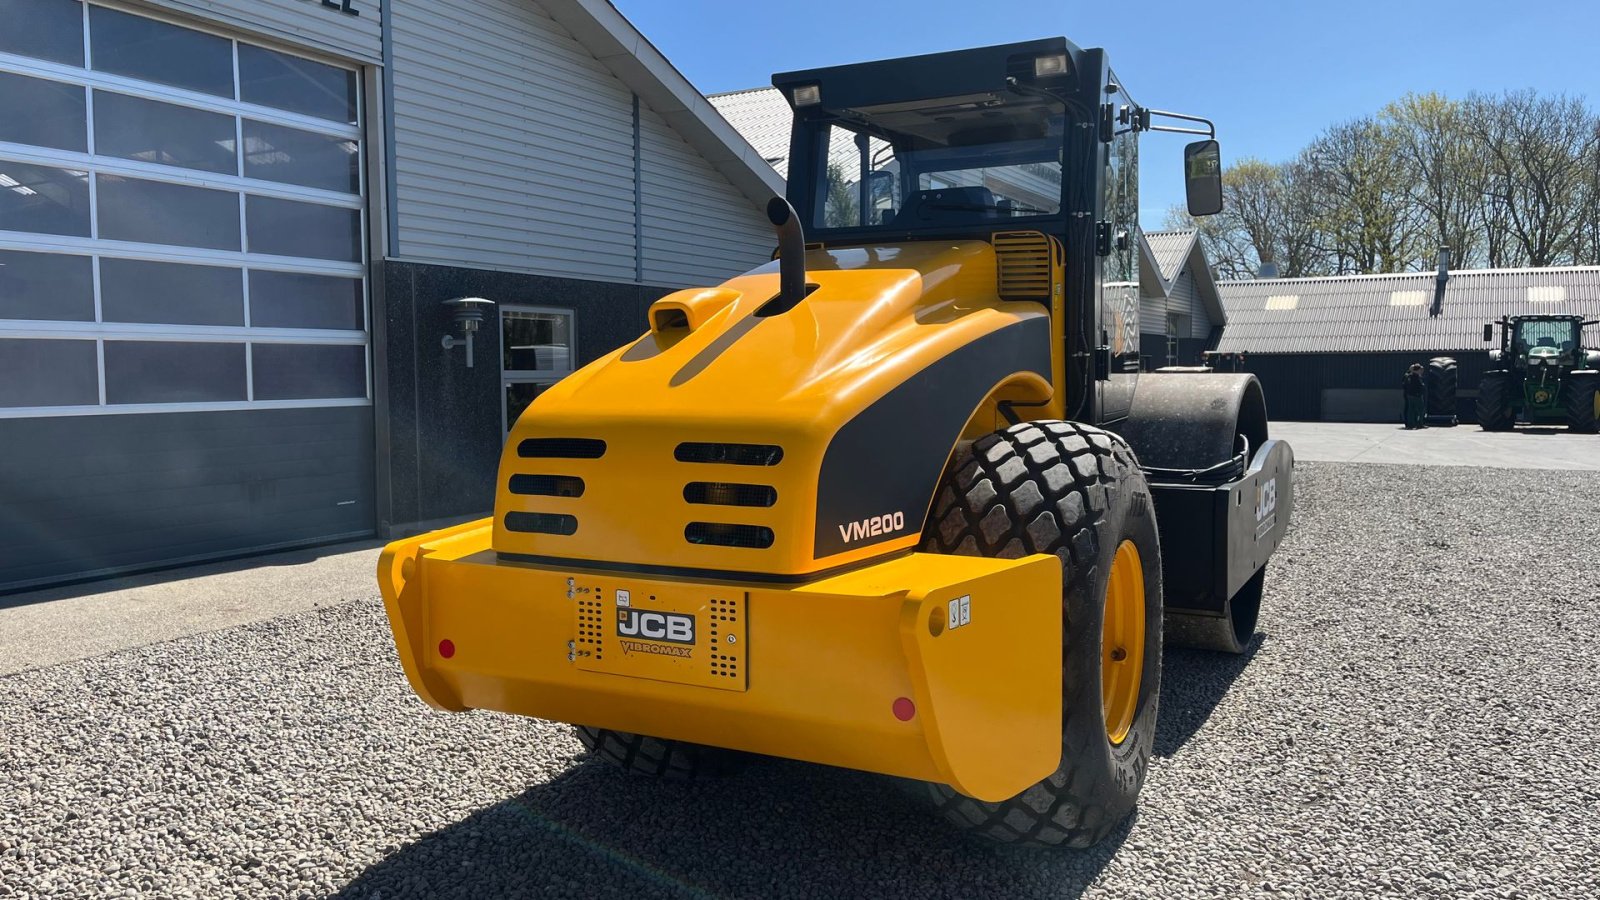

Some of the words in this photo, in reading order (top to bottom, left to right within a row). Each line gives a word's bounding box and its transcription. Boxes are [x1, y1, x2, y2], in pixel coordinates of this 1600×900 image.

[1256, 478, 1276, 521] JCB
[838, 511, 904, 543] VM200
[619, 611, 692, 639] JCB
[621, 641, 693, 658] VIBROMAX
